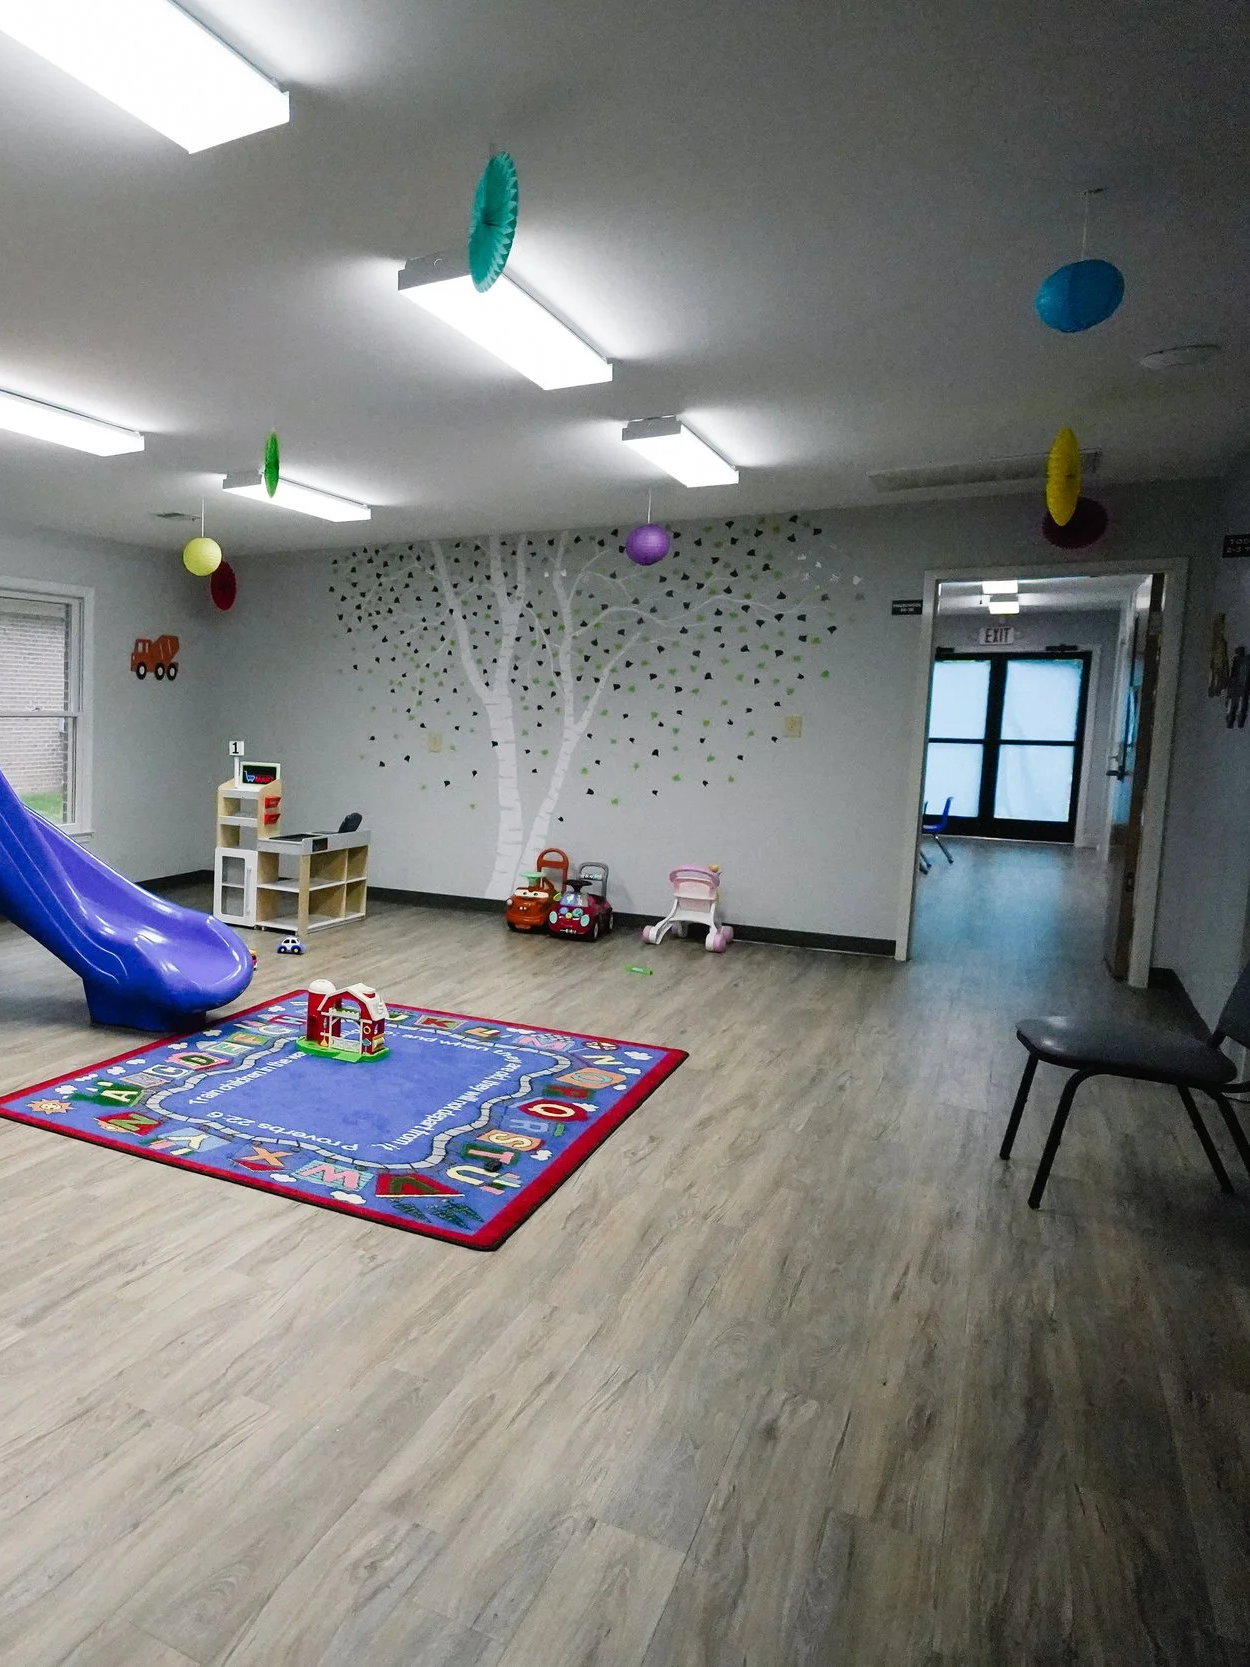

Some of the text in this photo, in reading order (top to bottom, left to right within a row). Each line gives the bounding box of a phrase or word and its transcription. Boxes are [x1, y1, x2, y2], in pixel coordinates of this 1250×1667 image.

[985, 627, 1011, 643] EXIT
[232, 742, 239, 754] 1
[582, 1054, 625, 1066] N
[570, 1071, 613, 1084] O
[188, 1088, 225, 1105] Train
[218, 1070, 267, 1091] children
[100, 1089, 138, 1103] A
[442, 1100, 468, 1111] not
[527, 1103, 576, 1118] Q
[414, 1109, 456, 1131] depart
[257, 1122, 359, 1151] Proverbs
[391, 1128, 431, 1145] from
[489, 1133, 532, 1148] S
[165, 1133, 212, 1150] Y
[240, 1146, 293, 1168] X
[300, 1163, 361, 1190] W
[468, 1149, 515, 1164] T
[446, 1165, 500, 1186] U
